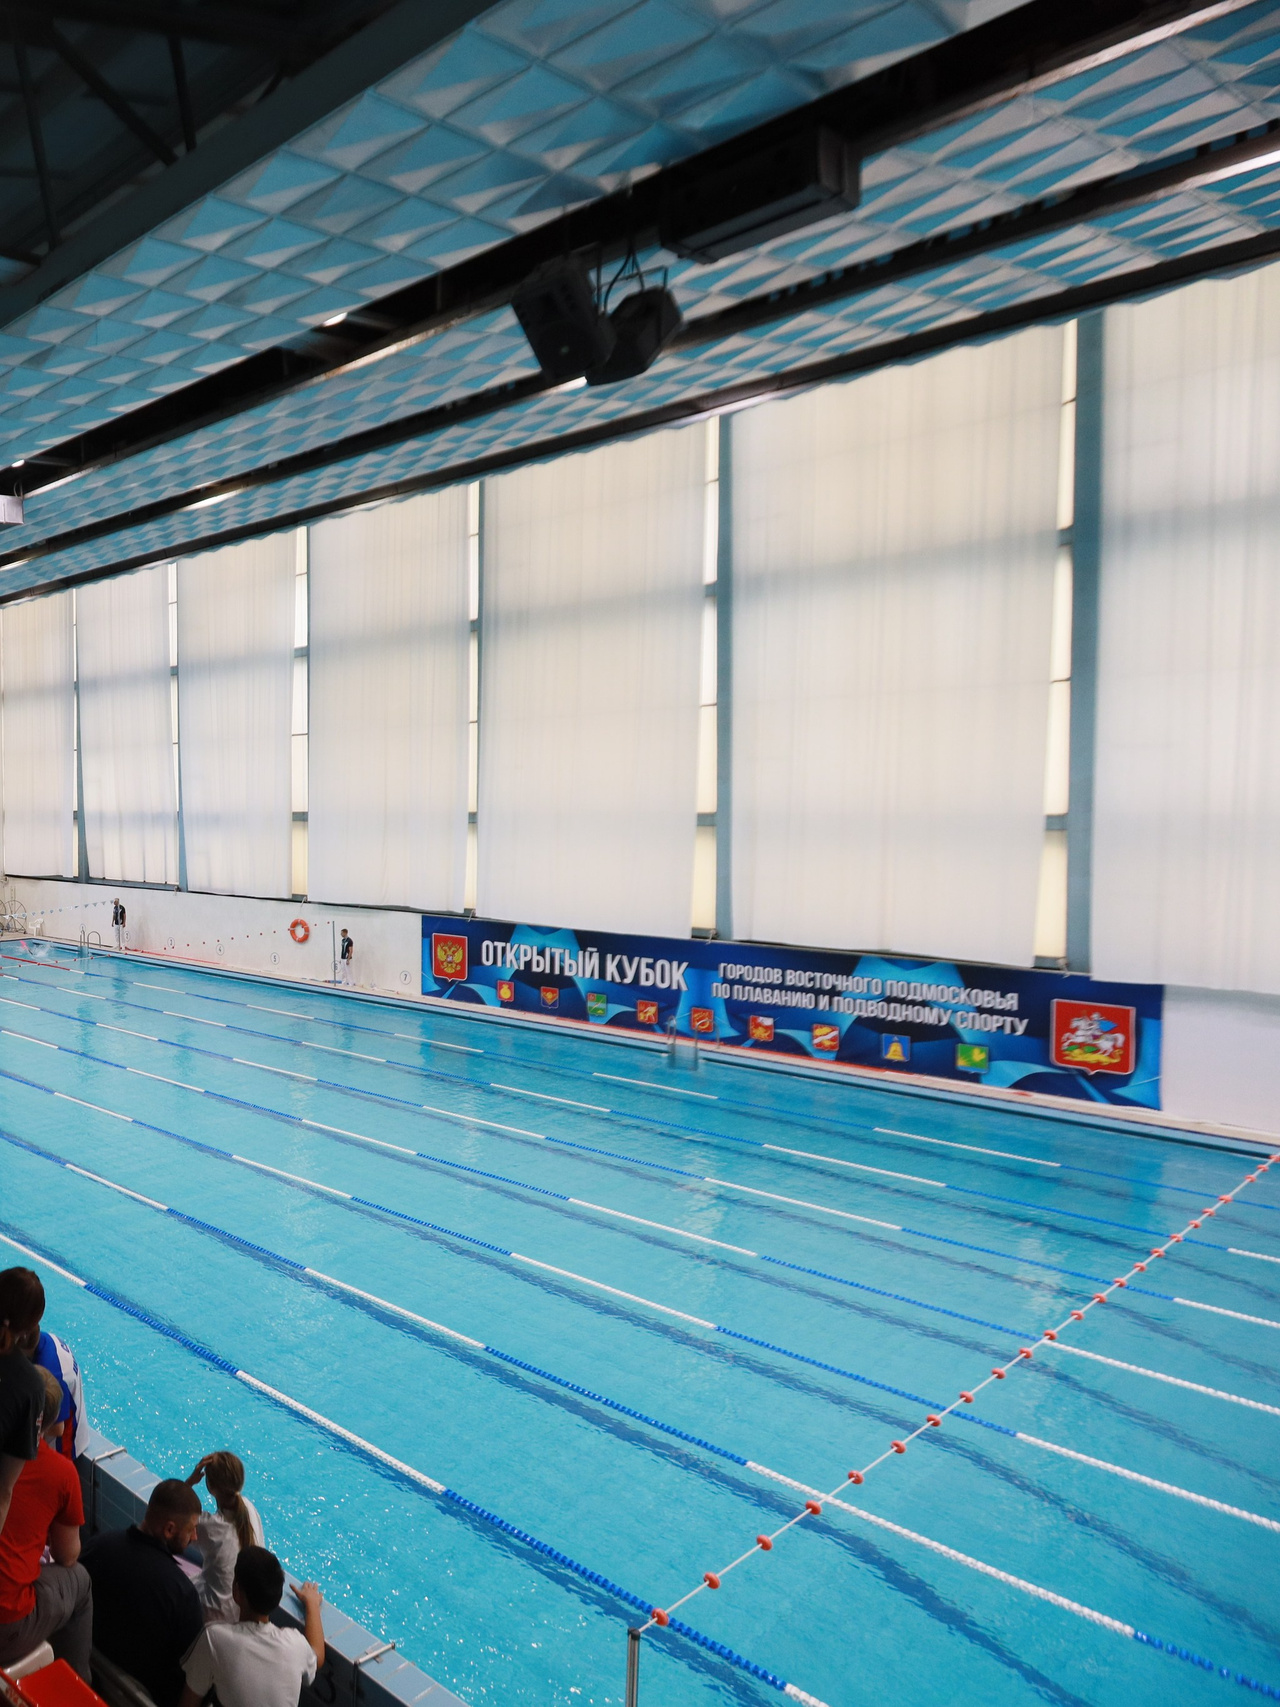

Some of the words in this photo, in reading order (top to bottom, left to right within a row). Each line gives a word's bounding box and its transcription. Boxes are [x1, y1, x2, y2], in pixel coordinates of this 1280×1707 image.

[481, 940, 600, 980] ОТКРЫТЫЙ
[605, 953, 690, 991] КУБОК
[718, 962, 783, 985] ГОРОДОВ
[785, 969, 883, 996] ВОСТОЧНОГО
[885, 980, 1019, 1011] ПОДМОСКОВЬЯ
[712, 982, 731, 999] ПО
[732, 984, 817, 1010] ПЛАВАНИЮ
[819, 993, 831, 1011] И
[832, 996, 953, 1027] ПОДВОДНОМУ
[955, 1010, 1029, 1036] СПОРТУ
